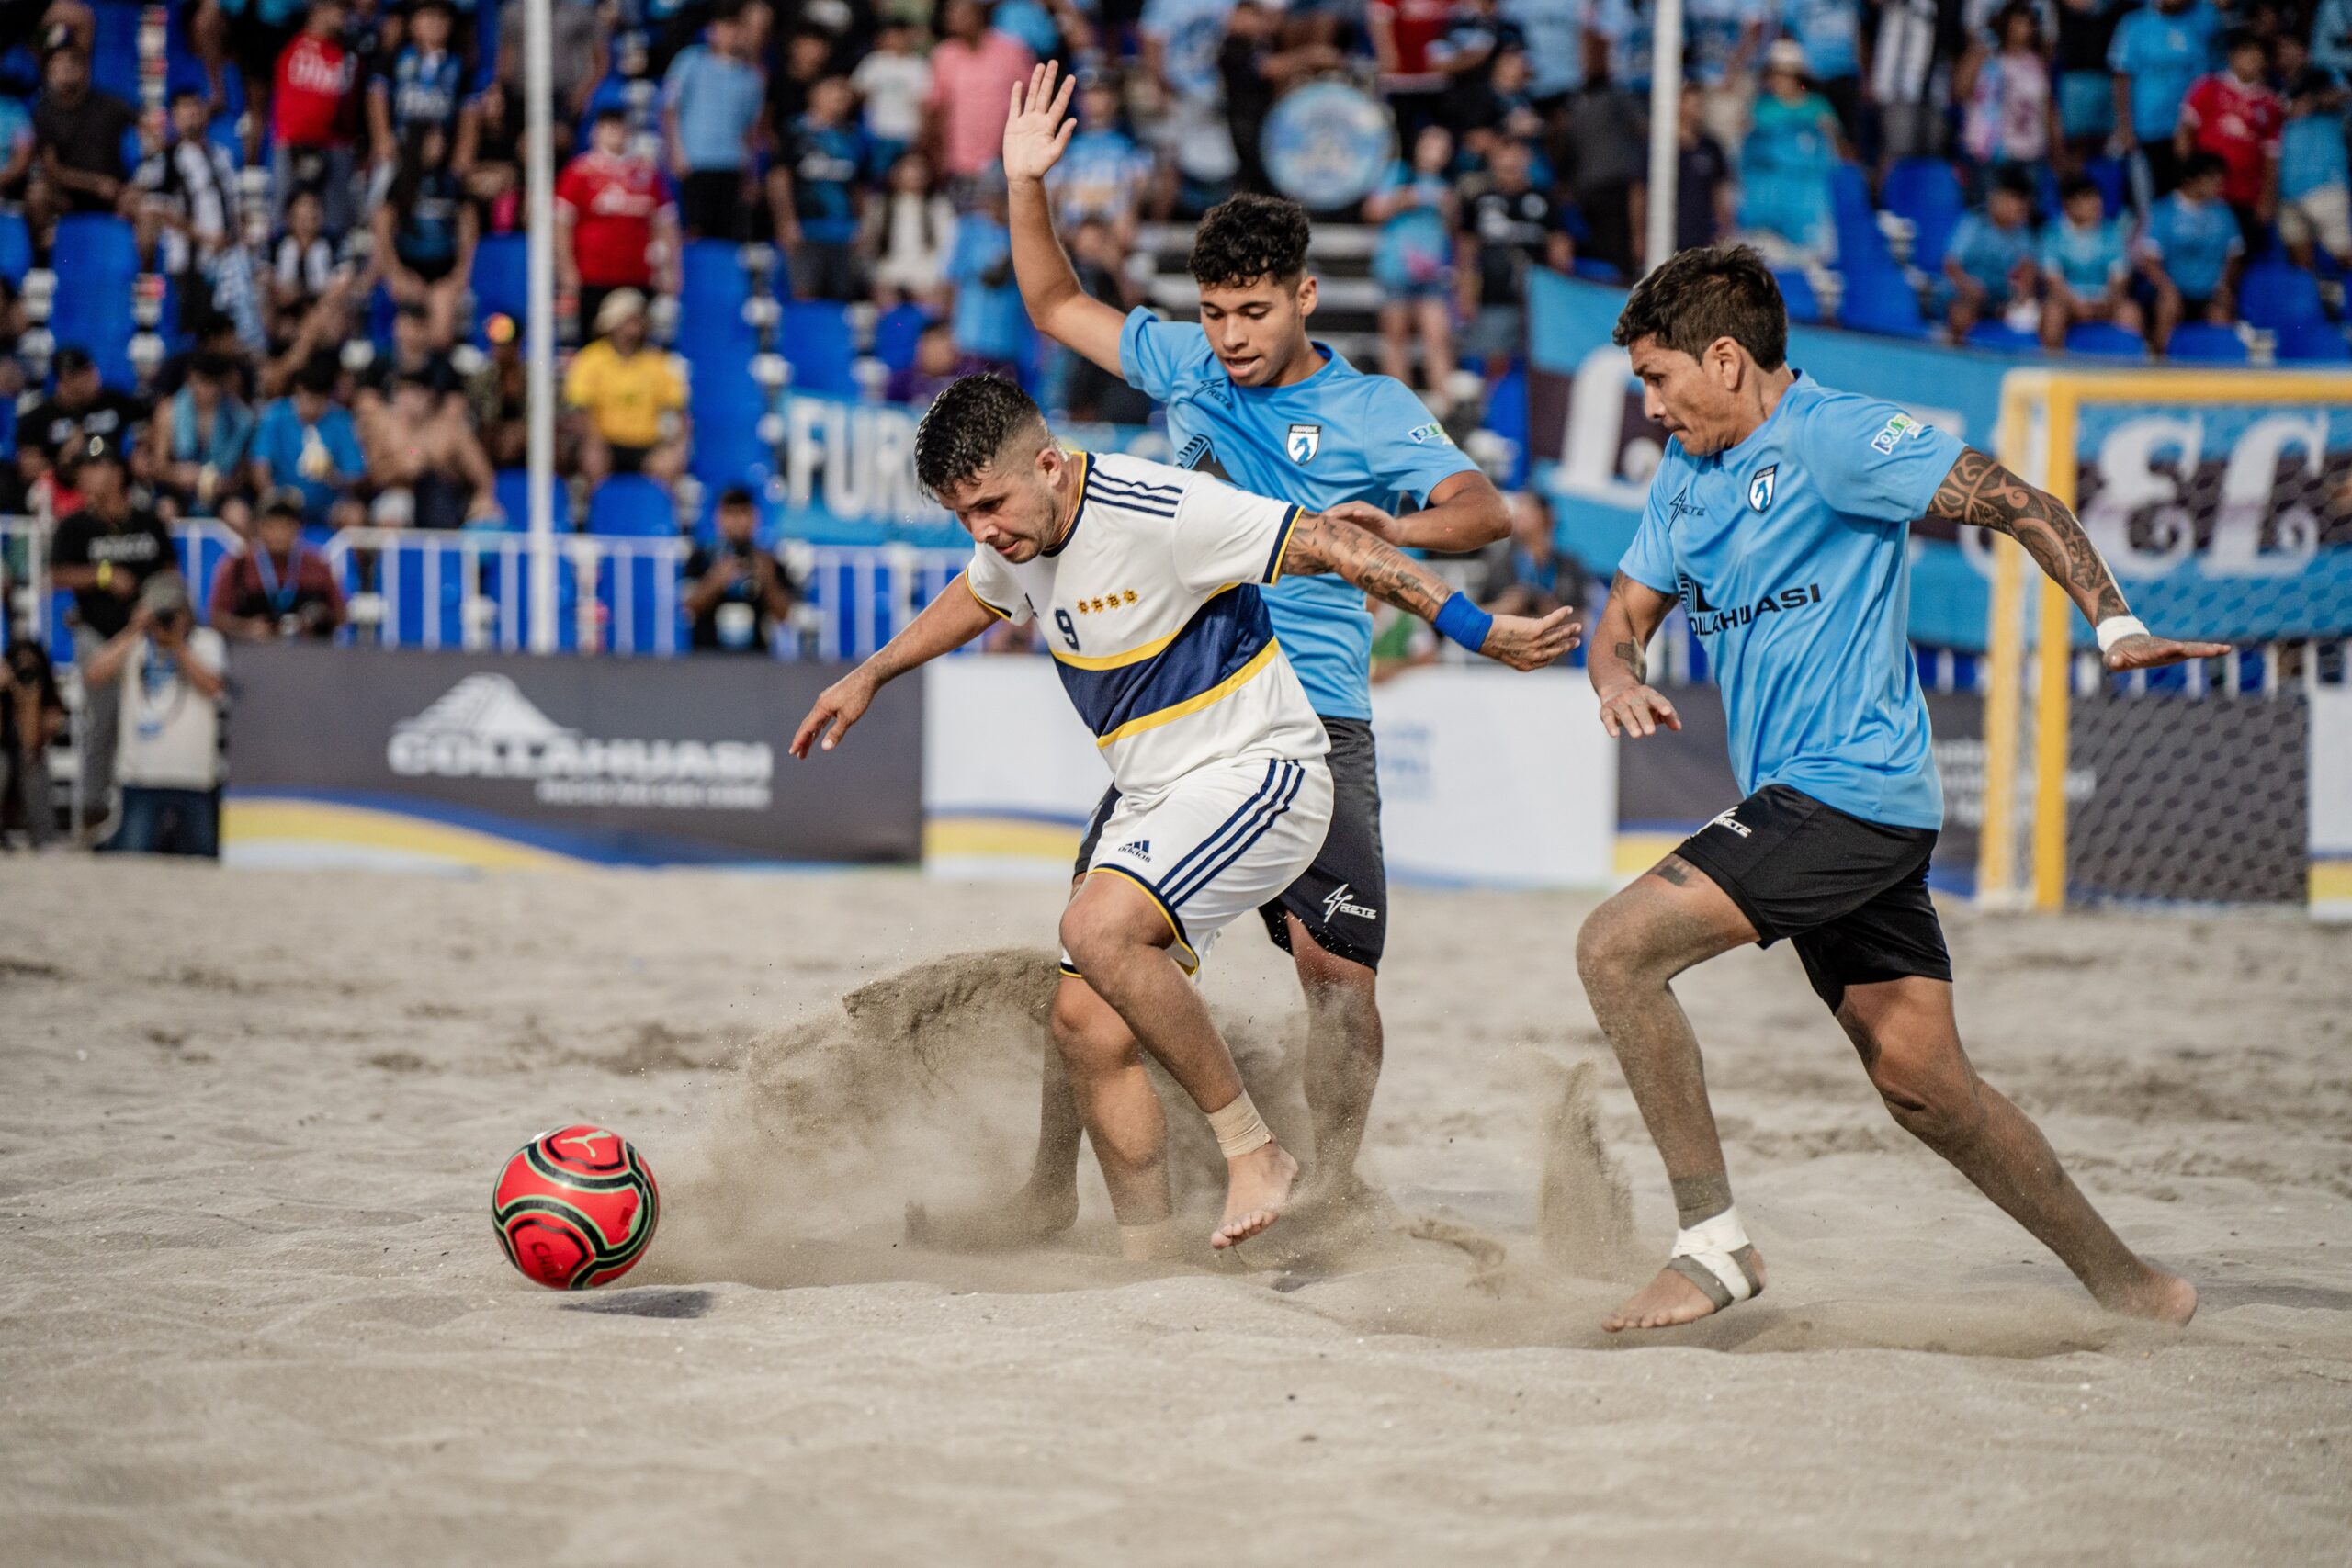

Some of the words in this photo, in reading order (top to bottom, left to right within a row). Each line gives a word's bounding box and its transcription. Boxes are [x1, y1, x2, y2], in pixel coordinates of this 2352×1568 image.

[786, 395, 956, 529] FUR
[1054, 609, 1081, 651] 9
[1688, 583, 1822, 636] OLLAHUASI
[1117, 844, 1152, 863] adidas
